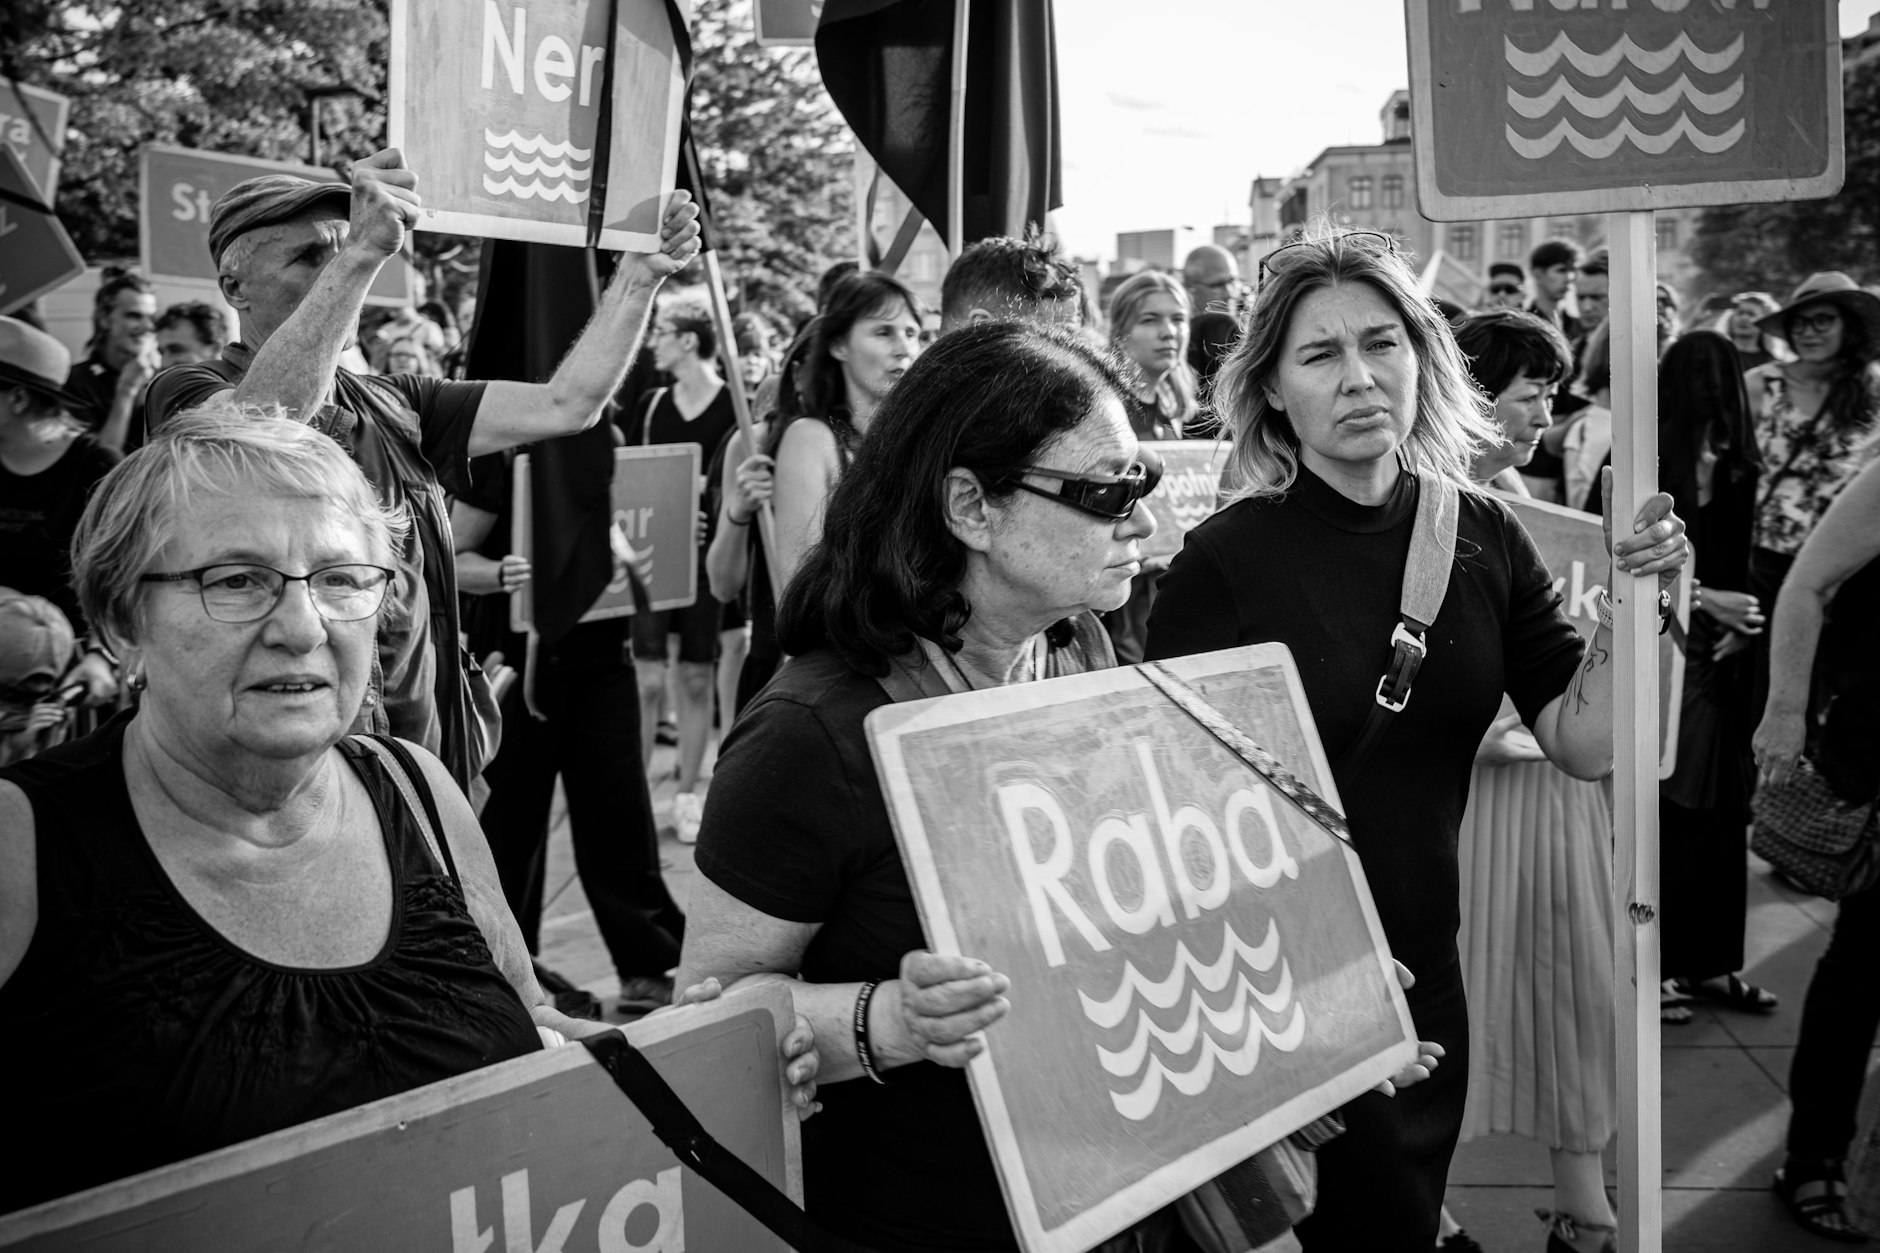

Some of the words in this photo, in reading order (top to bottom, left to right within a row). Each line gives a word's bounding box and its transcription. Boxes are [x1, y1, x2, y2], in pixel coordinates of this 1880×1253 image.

[481, 0, 605, 107] Ner
[171, 182, 211, 224] St
[998, 736, 1298, 967] Raba
